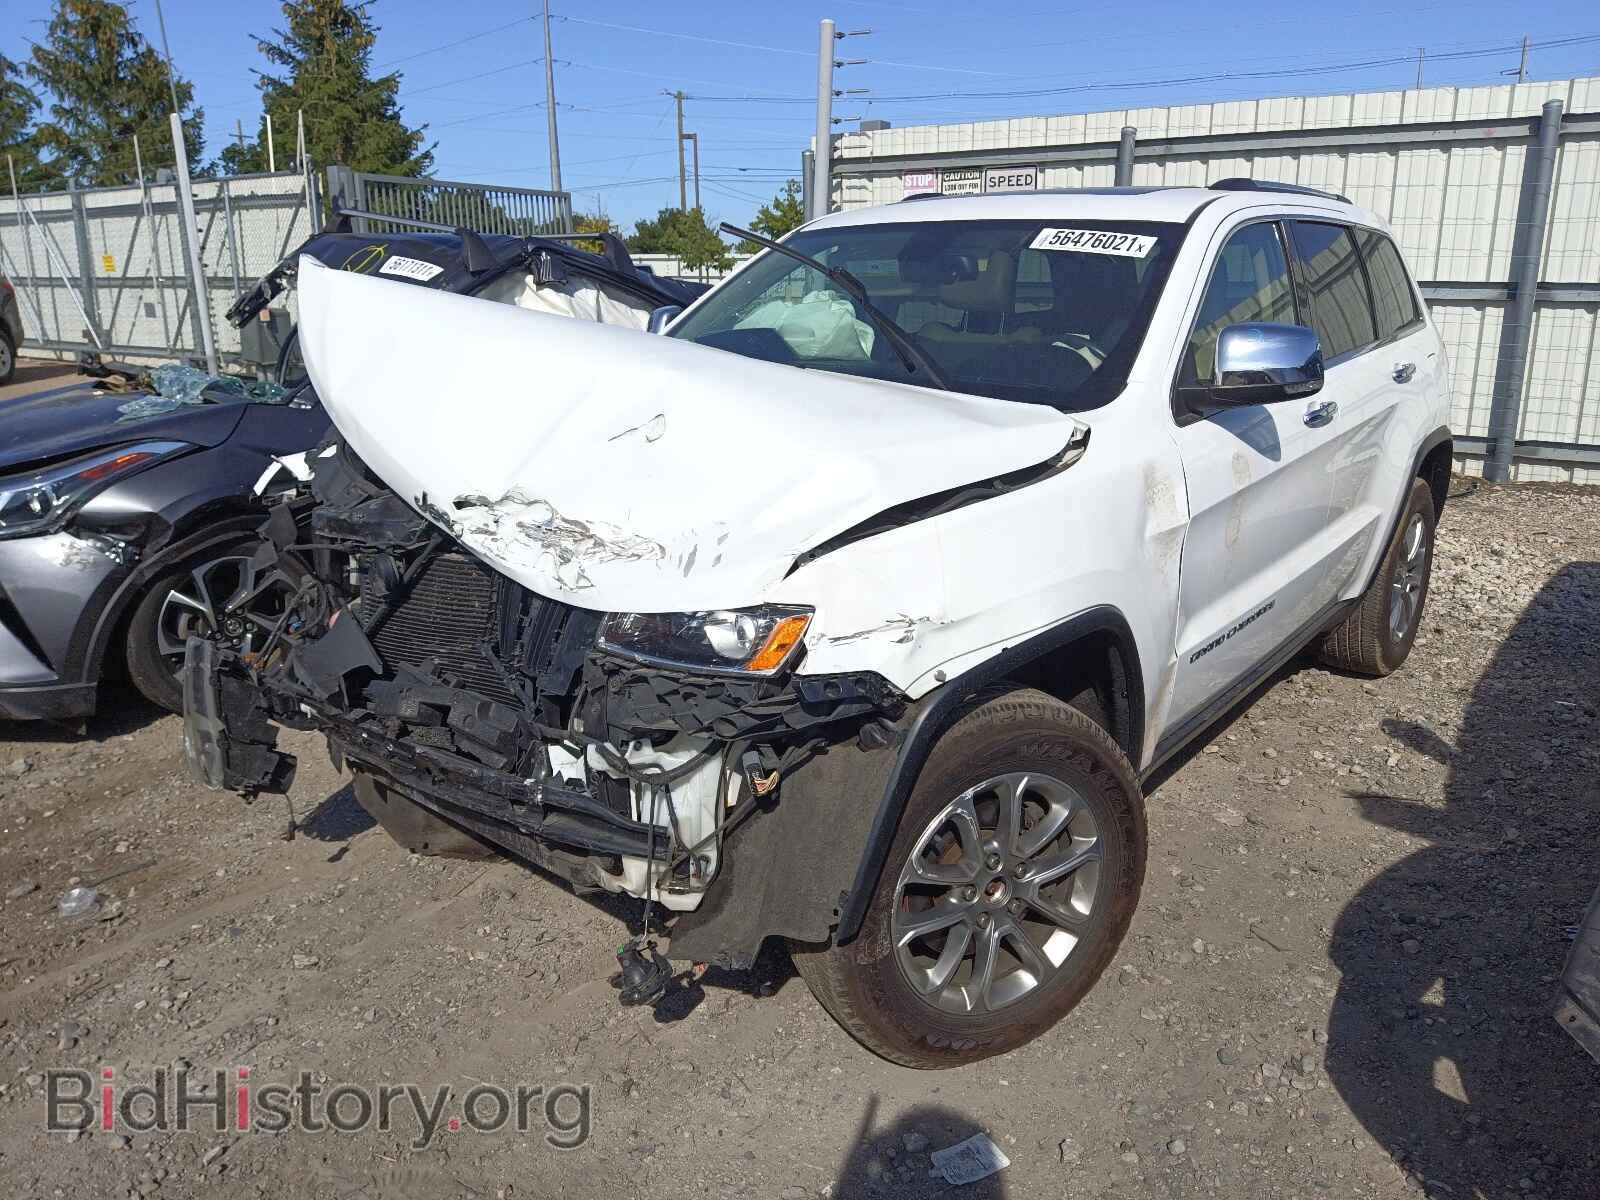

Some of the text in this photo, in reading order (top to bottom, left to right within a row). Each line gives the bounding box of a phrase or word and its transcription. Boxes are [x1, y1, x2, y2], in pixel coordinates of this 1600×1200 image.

[904, 173, 933, 187] STOP
[944, 171, 980, 181] CAUTION
[988, 174, 1033, 188] SPEED
[958, 183, 968, 191] OUT
[968, 182, 979, 190] FOR
